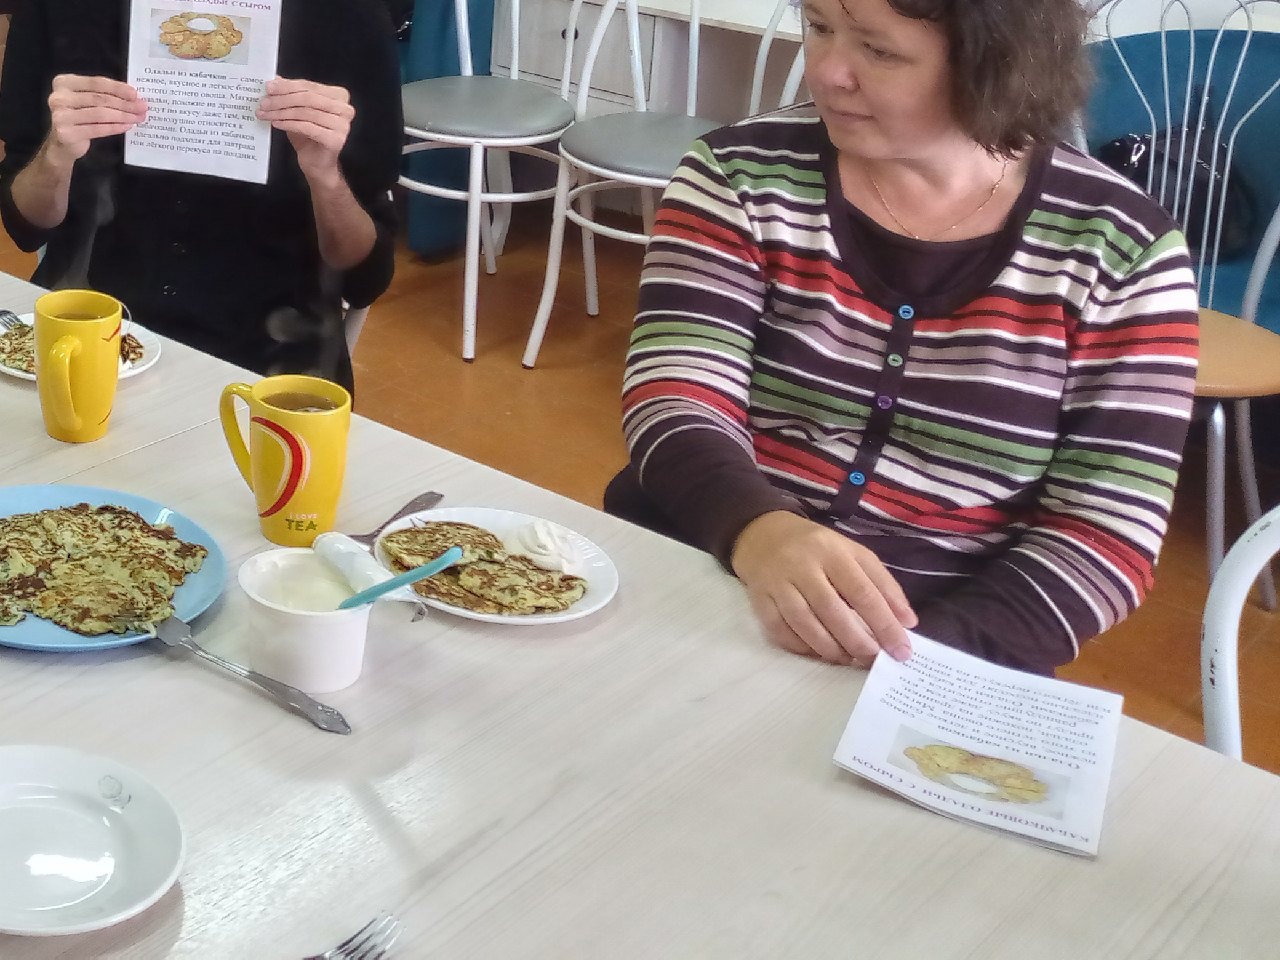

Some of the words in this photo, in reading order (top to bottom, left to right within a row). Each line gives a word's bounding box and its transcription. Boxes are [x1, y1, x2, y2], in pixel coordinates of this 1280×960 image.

[239, 1, 271, 10] СЫРОМ
[285, 518, 318, 531] TEA
[851, 755, 904, 784] СЫРОМ
[908, 782, 917, 790] С
[922, 788, 983, 814] ОЛАДЬИ
[989, 810, 1090, 843] КАБАЧКОВЫЕ
